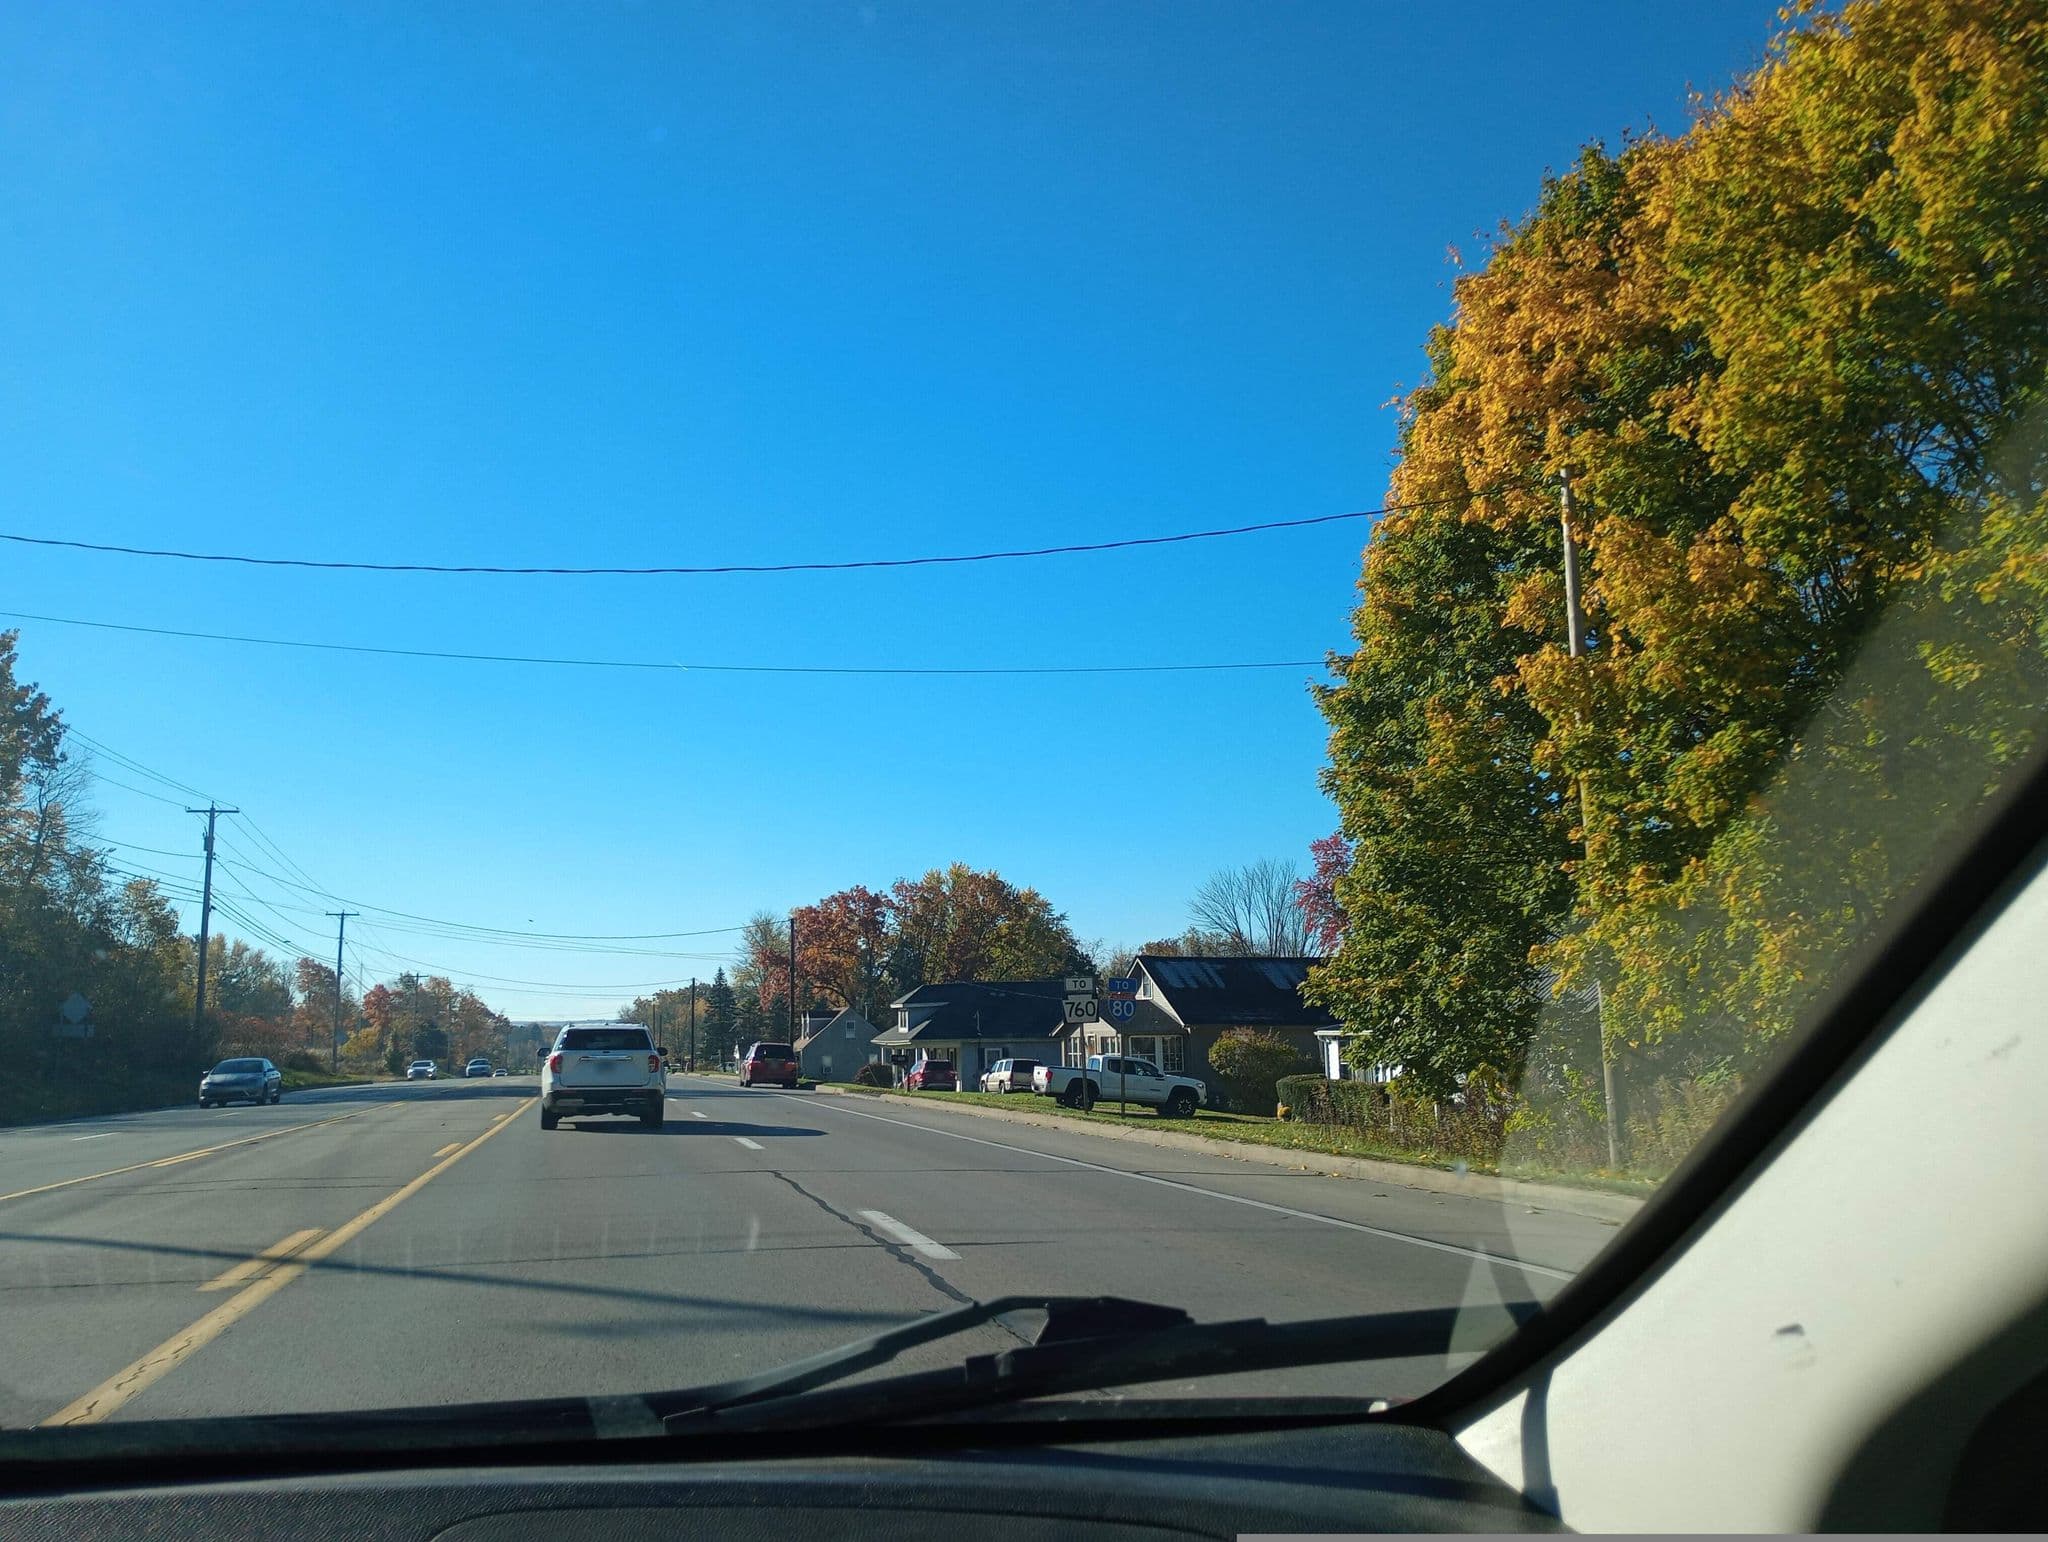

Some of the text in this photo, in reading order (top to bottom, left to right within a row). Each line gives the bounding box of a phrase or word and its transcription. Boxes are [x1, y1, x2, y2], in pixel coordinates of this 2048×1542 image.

[1072, 980, 1086, 988] TO
[1115, 981, 1129, 990] TO
[1065, 1001, 1096, 1017] 760
[1112, 1001, 1134, 1017] 80
